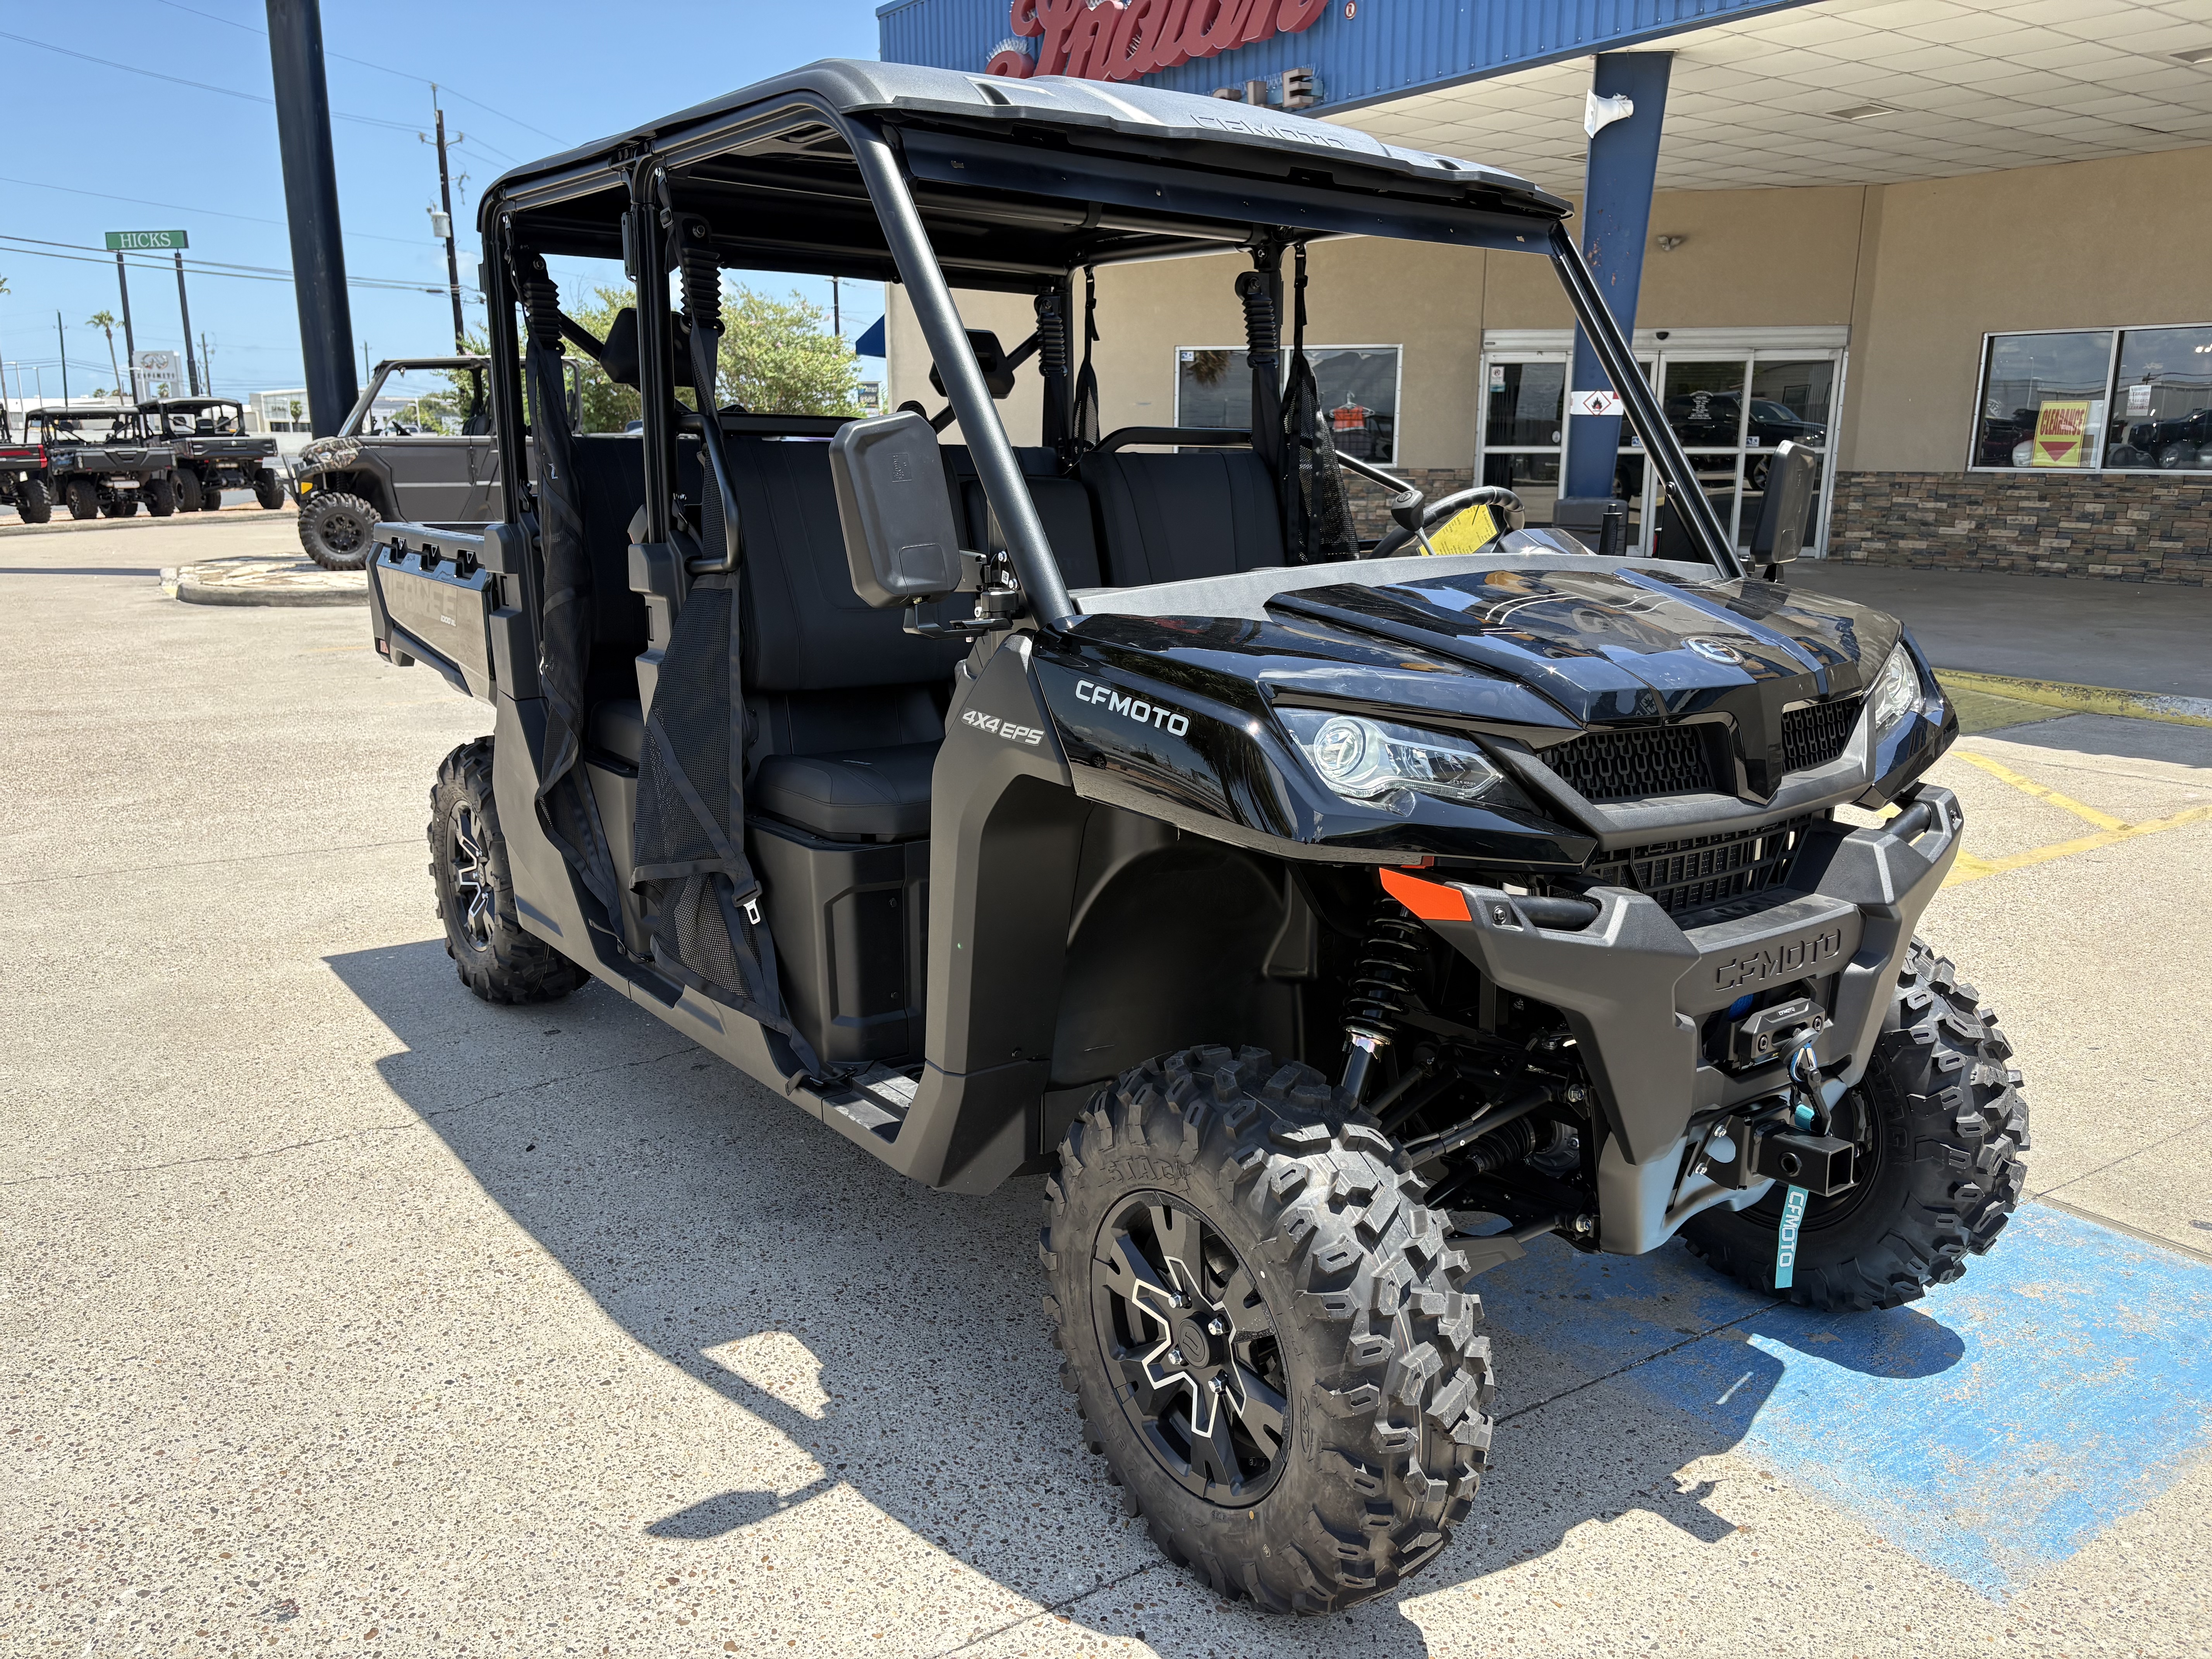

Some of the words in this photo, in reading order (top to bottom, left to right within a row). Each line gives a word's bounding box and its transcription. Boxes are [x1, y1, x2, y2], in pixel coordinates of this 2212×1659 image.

[120, 232, 171, 248] HICKS
[2040, 408, 2085, 436] CLEARANCE
[440, 615, 451, 625] 1000
[1075, 680, 1189, 737] CFMOTO
[962, 710, 1001, 732] 4X4
[999, 722, 1045, 745] EPS
[1714, 928, 1841, 991] CFMOTO
[1778, 1007, 1795, 1016] CFMOTO
[1779, 1191, 1804, 1267] CFMOTO
